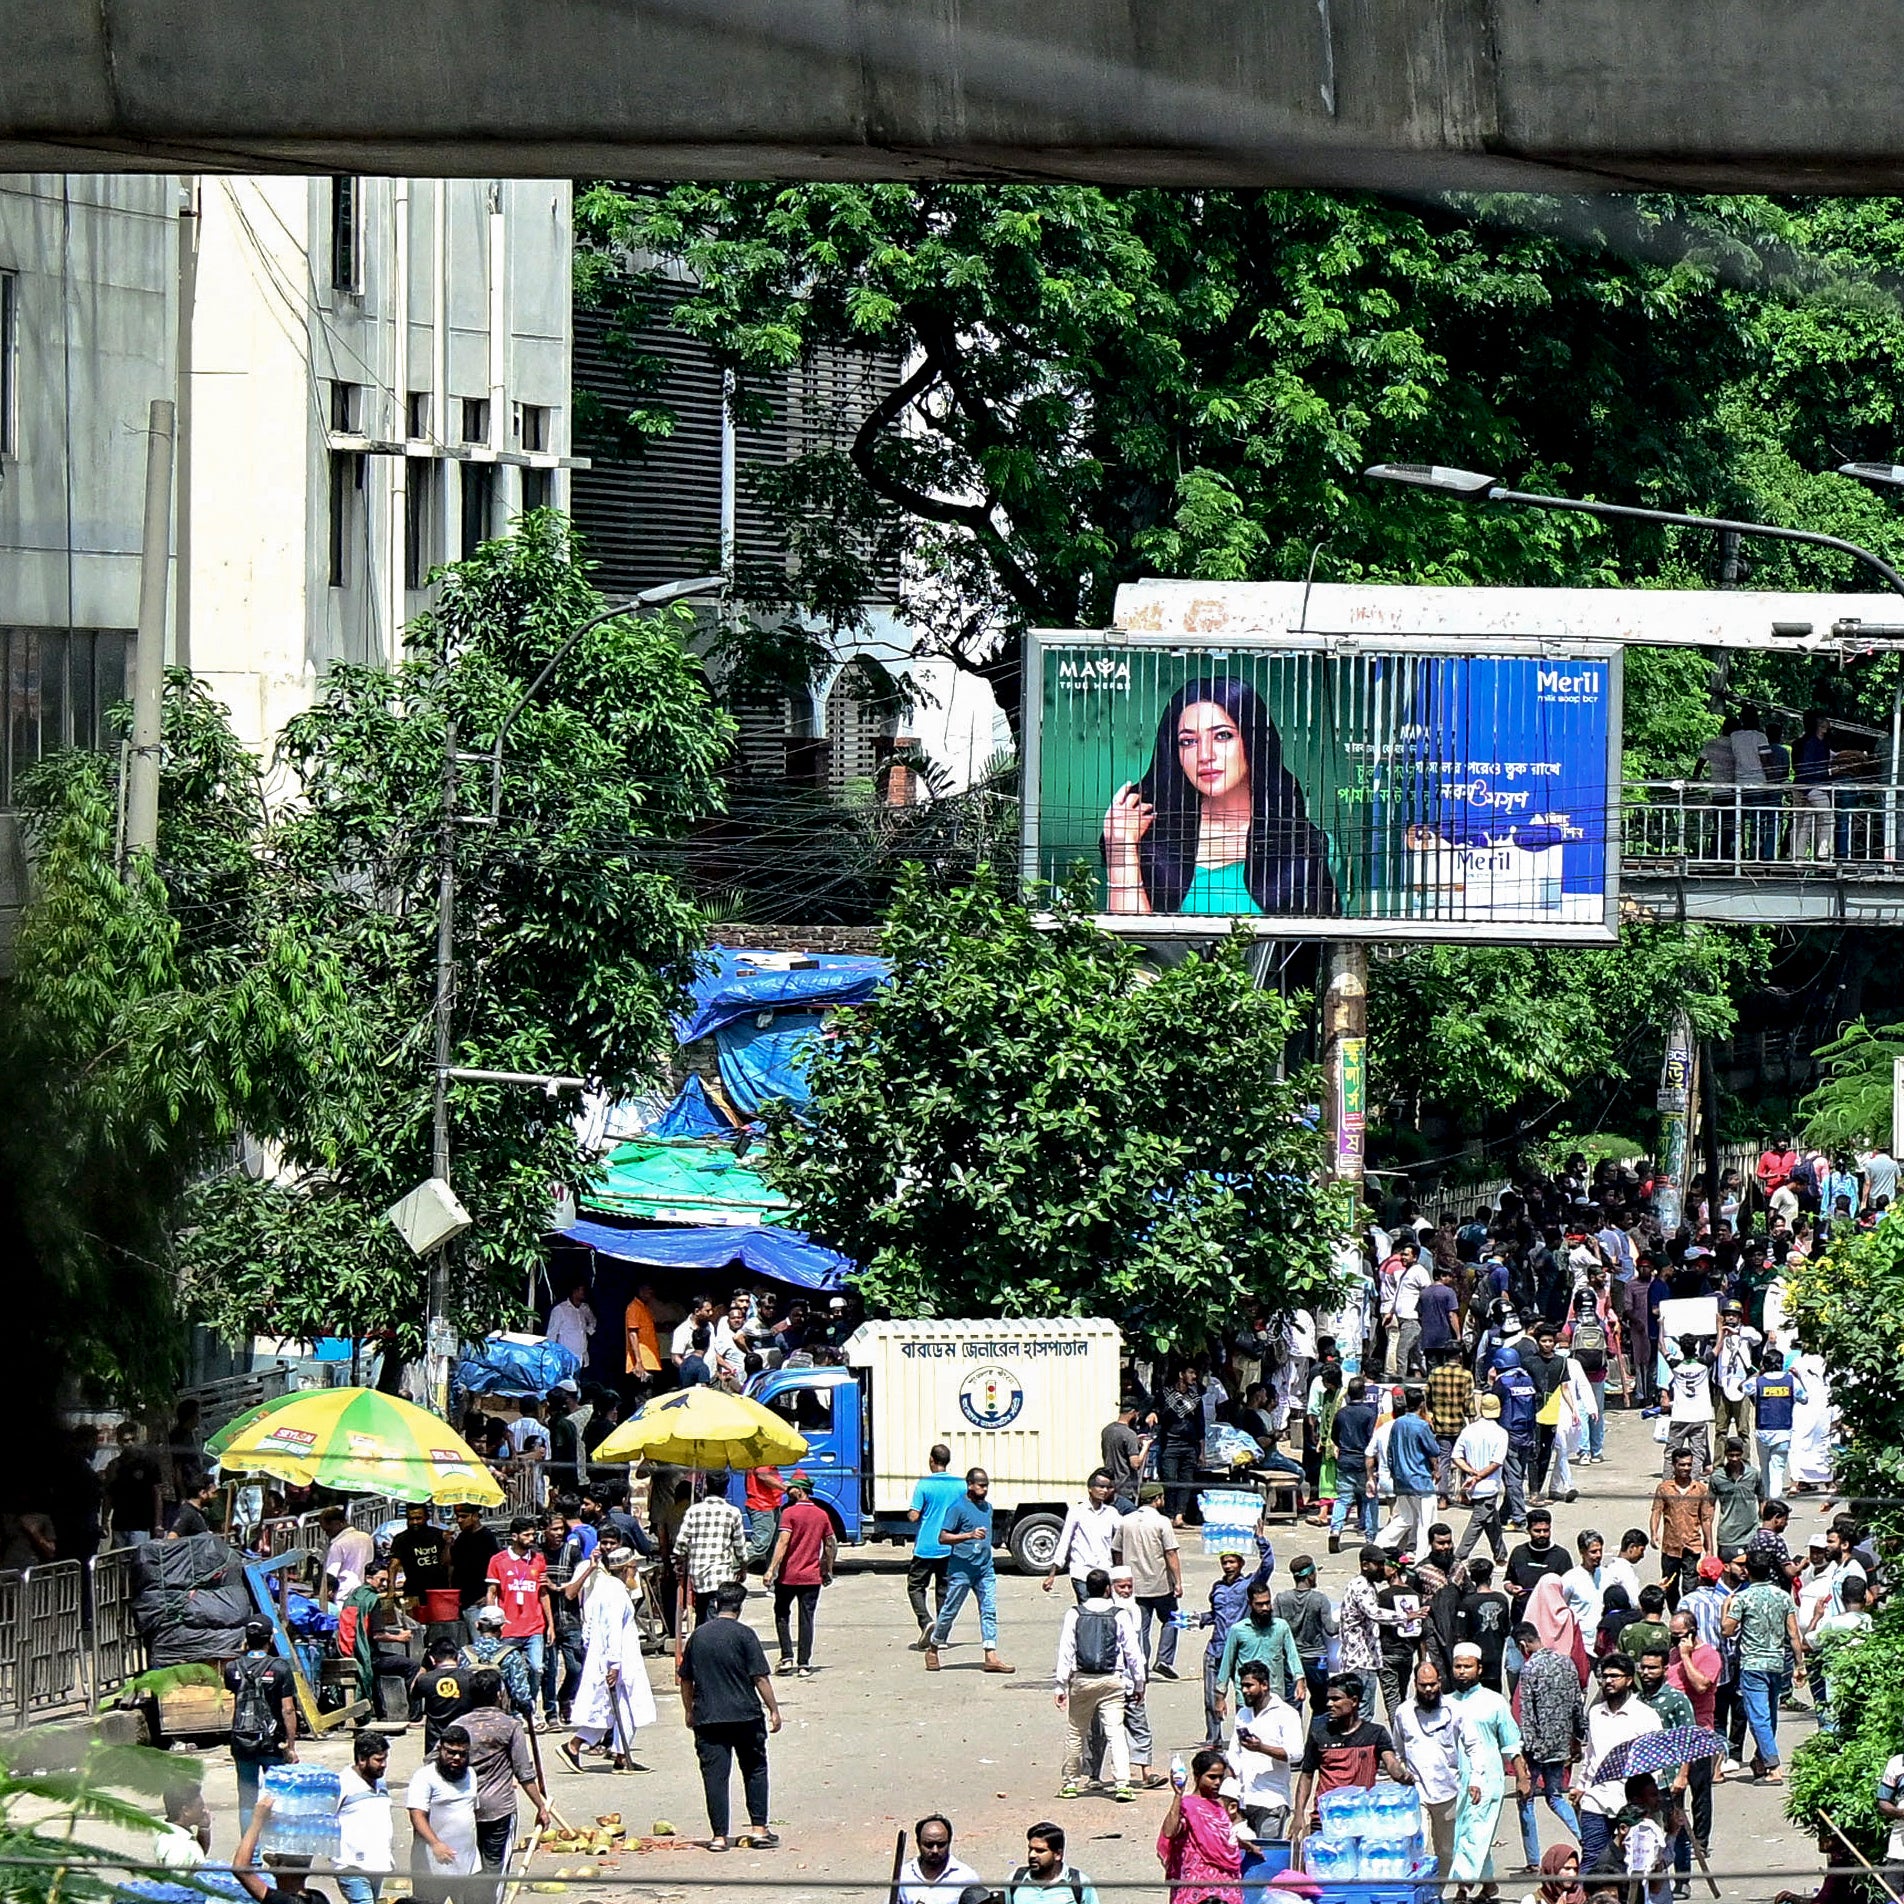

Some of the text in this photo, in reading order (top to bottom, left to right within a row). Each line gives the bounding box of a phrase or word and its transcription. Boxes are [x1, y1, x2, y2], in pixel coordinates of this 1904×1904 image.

[1538, 671, 1598, 693] Meril
[1457, 852, 1510, 870] Meril
[900, 1339, 1088, 1359] বারডেম জেনারেল হাসপাতাল
